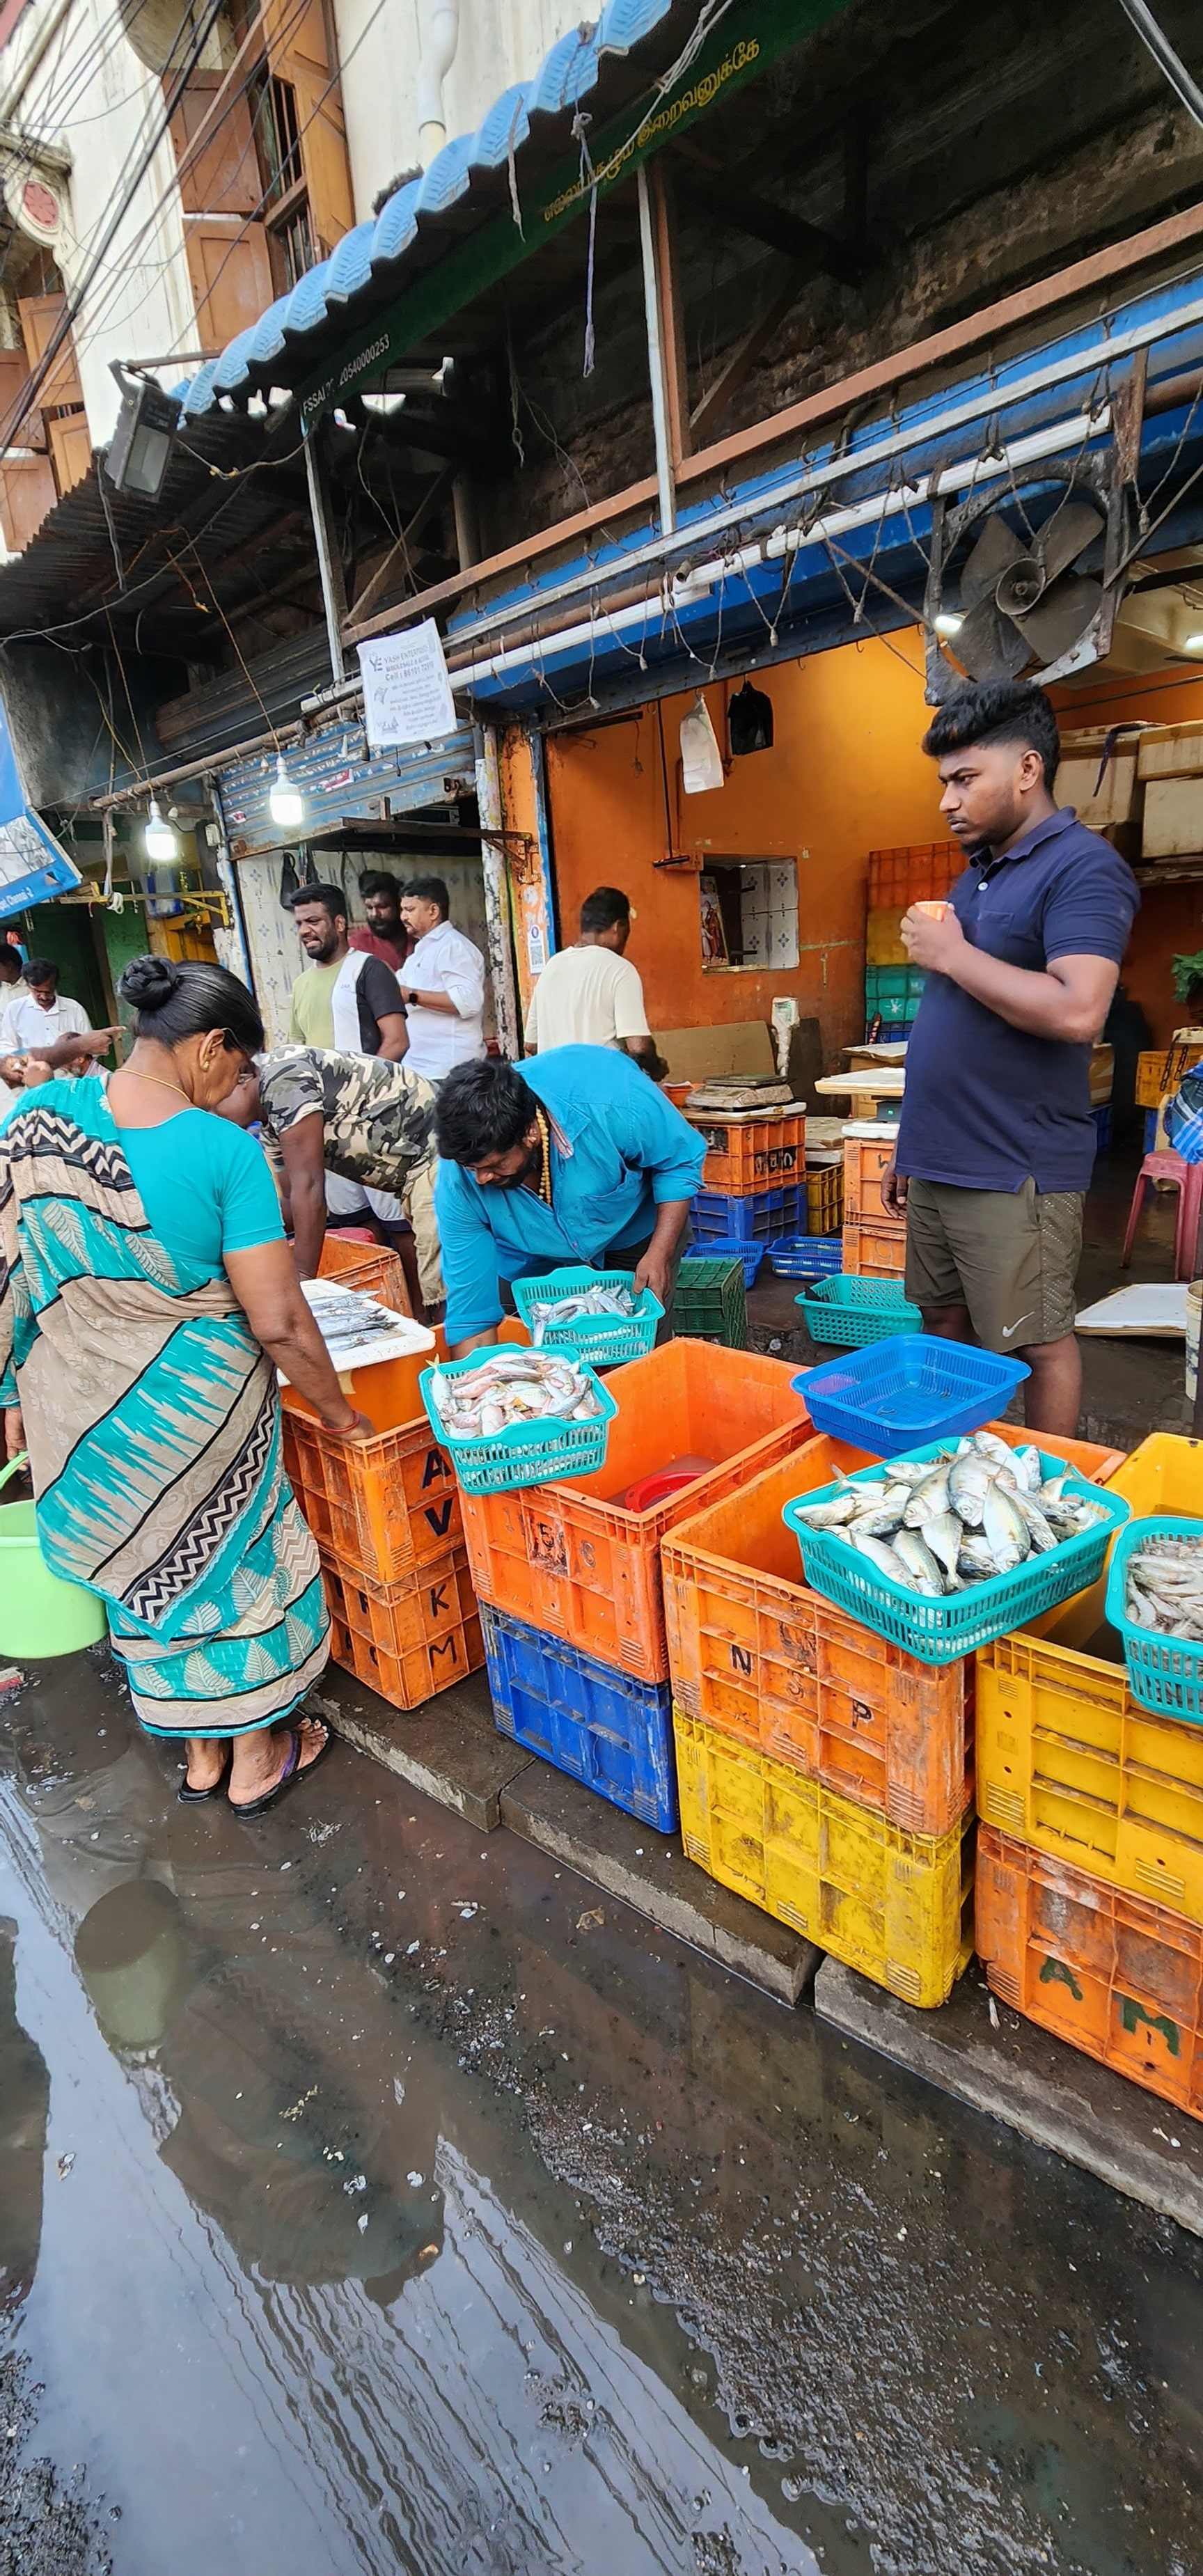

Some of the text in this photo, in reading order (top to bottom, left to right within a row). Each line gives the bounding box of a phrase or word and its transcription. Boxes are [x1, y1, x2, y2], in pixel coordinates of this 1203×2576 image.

[303, 386, 326, 417] FSSAI
[422, 1447, 452, 1490] A
[424, 1497, 454, 1537] V
[430, 1583, 450, 1618] K
[428, 1636, 457, 1670] M
[730, 1643, 753, 1676] N
[851, 1699, 875, 1729] P
[1039, 1954, 1083, 2002] A
